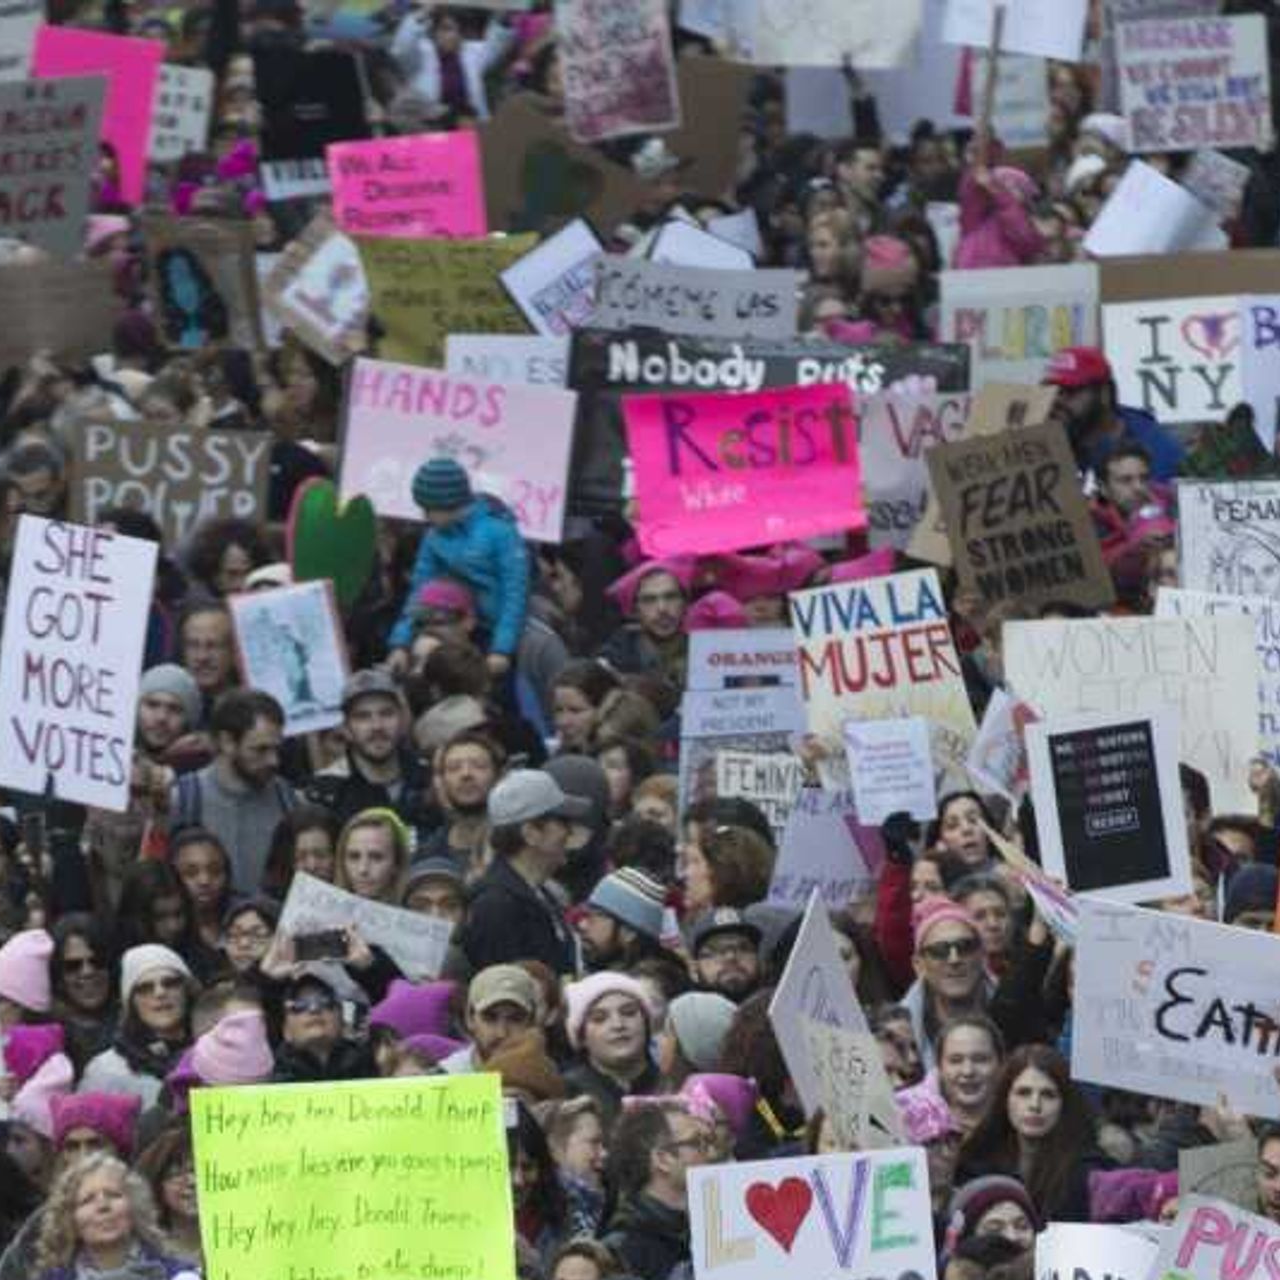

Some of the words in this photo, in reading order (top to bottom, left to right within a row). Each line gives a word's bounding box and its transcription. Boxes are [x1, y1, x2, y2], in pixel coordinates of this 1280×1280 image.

[607, 340, 766, 395] Nobody
[1138, 313, 1171, 364] I
[354, 365, 507, 427] HANDS
[1139, 363, 1234, 411] NY
[83, 424, 276, 487] PUSSY
[958, 463, 1062, 538] FEAR
[32, 522, 114, 585] SHE
[966, 519, 1078, 569] STRONG
[973, 552, 1088, 603] WOMEN
[25, 587, 117, 645] GOT
[793, 589, 881, 640] VIVA
[886, 579, 945, 625] LA
[21, 650, 116, 719] MORE
[797, 623, 962, 700] MUJER
[10, 716, 125, 788] VOTES
